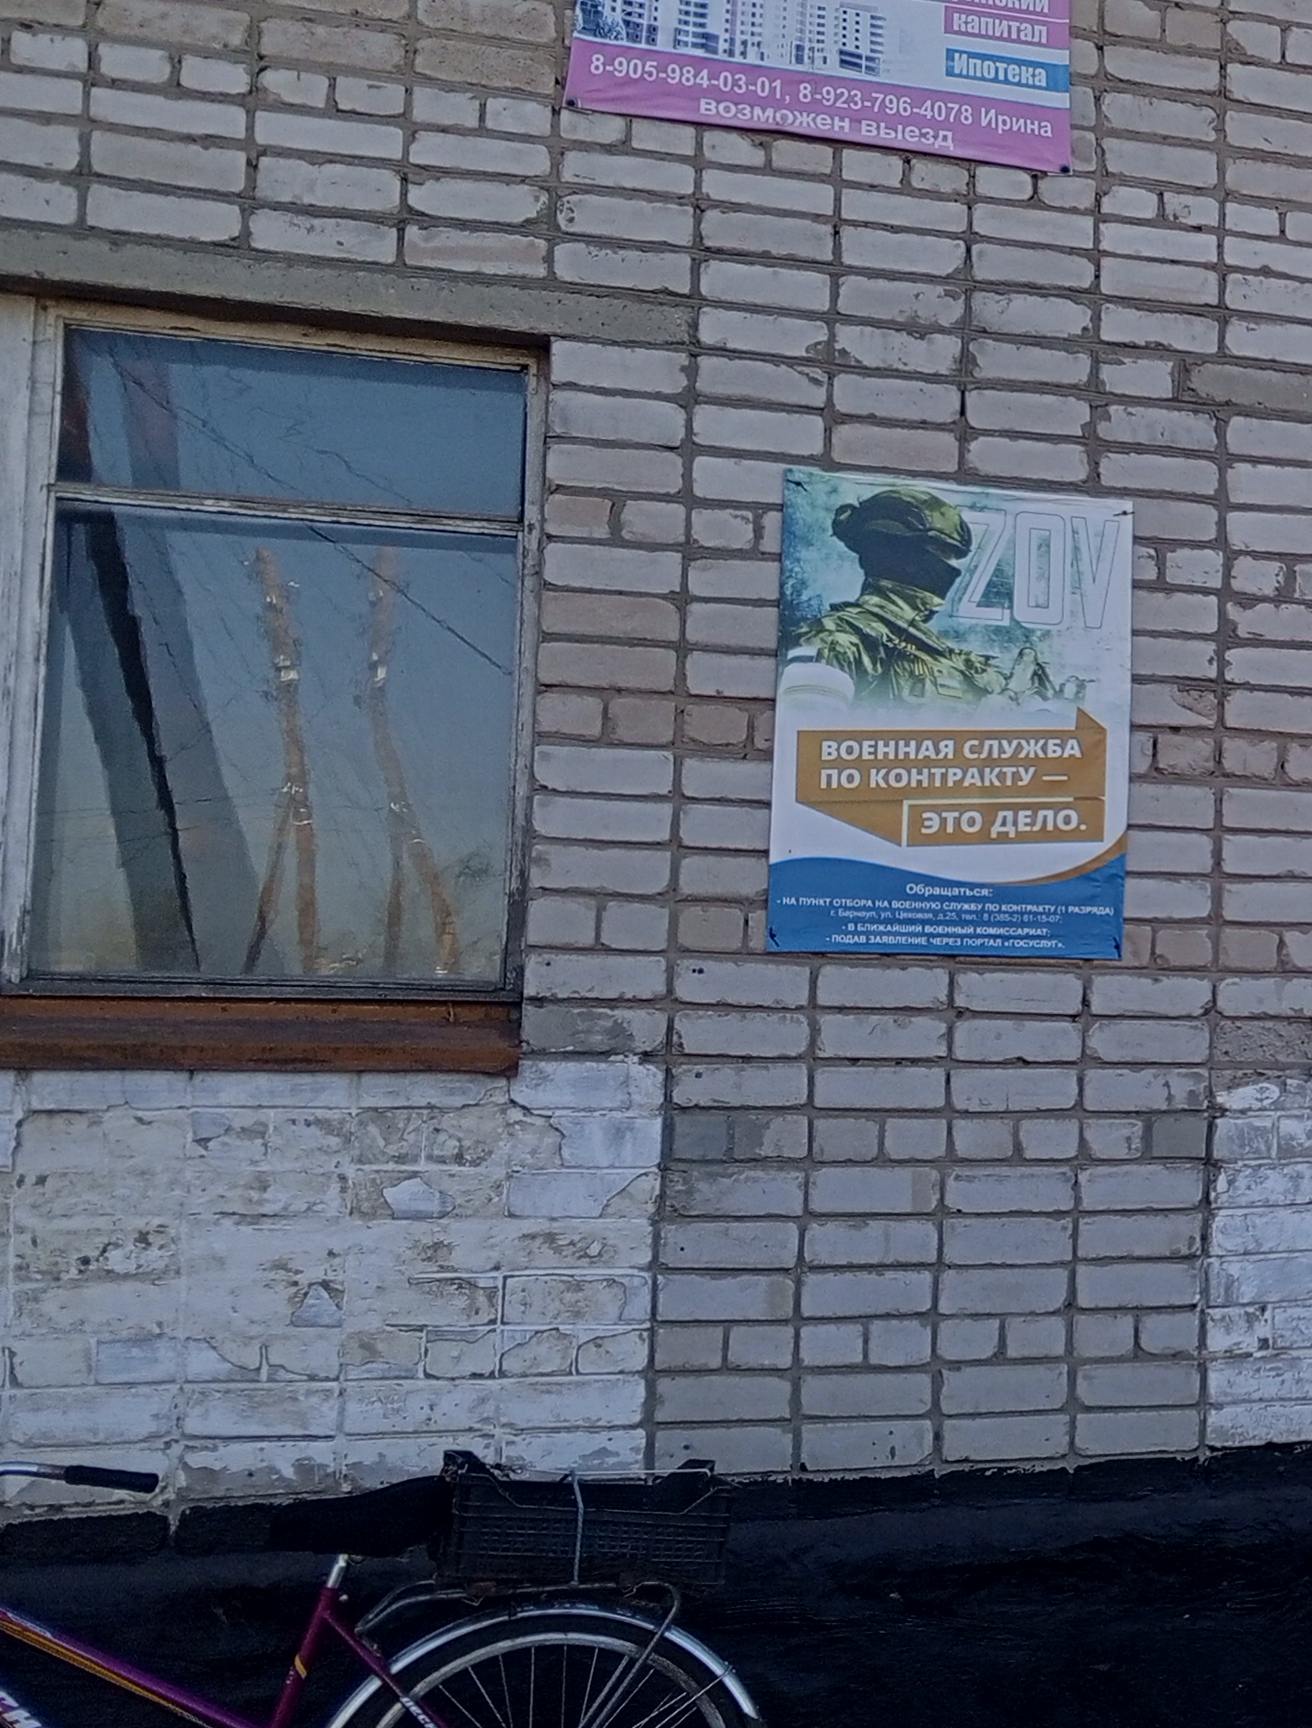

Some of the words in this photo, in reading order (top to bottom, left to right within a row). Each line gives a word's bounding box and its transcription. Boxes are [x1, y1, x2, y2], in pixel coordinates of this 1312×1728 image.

[953, 13, 1048, 44] капитал
[953, 52, 1048, 88] Ипотека
[589, 53, 791, 104] 8-905-984-03-01,
[798, 83, 973, 126] 8-923-796-4078
[980, 106, 1053, 138] Ирина
[699, 97, 851, 133] возможен
[860, 119, 954, 151] выезд
[949, 504, 1121, 630] ZOV
[820, 739, 955, 762] ВОЕННАЯ
[962, 738, 1083, 760] СЛУЖБА
[819, 768, 861, 789] ПО
[868, 766, 1037, 788] КОНТРАКТУ
[920, 810, 983, 834] ЭТО
[989, 808, 1088, 839] ДЕЛО.
[905, 883, 994, 898] Обращаться:
[783, 896, 798, 906] НА
[799, 897, 832, 907] ПУНКТ
[832, 898, 874, 908] ОТБОРА
[876, 899, 890, 908] НА
[891, 900, 941, 910] ВОЕННУЮ
[942, 901, 982, 911] СЛУЖБУ
[985, 903, 1000, 912] ПО
[1001, 903, 1057, 914] КОНТРАКТУ
[831, 935, 867, 944] ПОДАВ
[868, 936, 928, 945] ЗАЯВЛЕНИЕ
[929, 937, 961, 946] ЧЕРЕЗ
[963, 938, 1003, 947] ПОРТАЛ
[847, 923, 856, 931] В
[856, 922, 923, 932] БЛИЖАЙШИЙ
[924, 924, 974, 935] ВОЕННЫЙ
